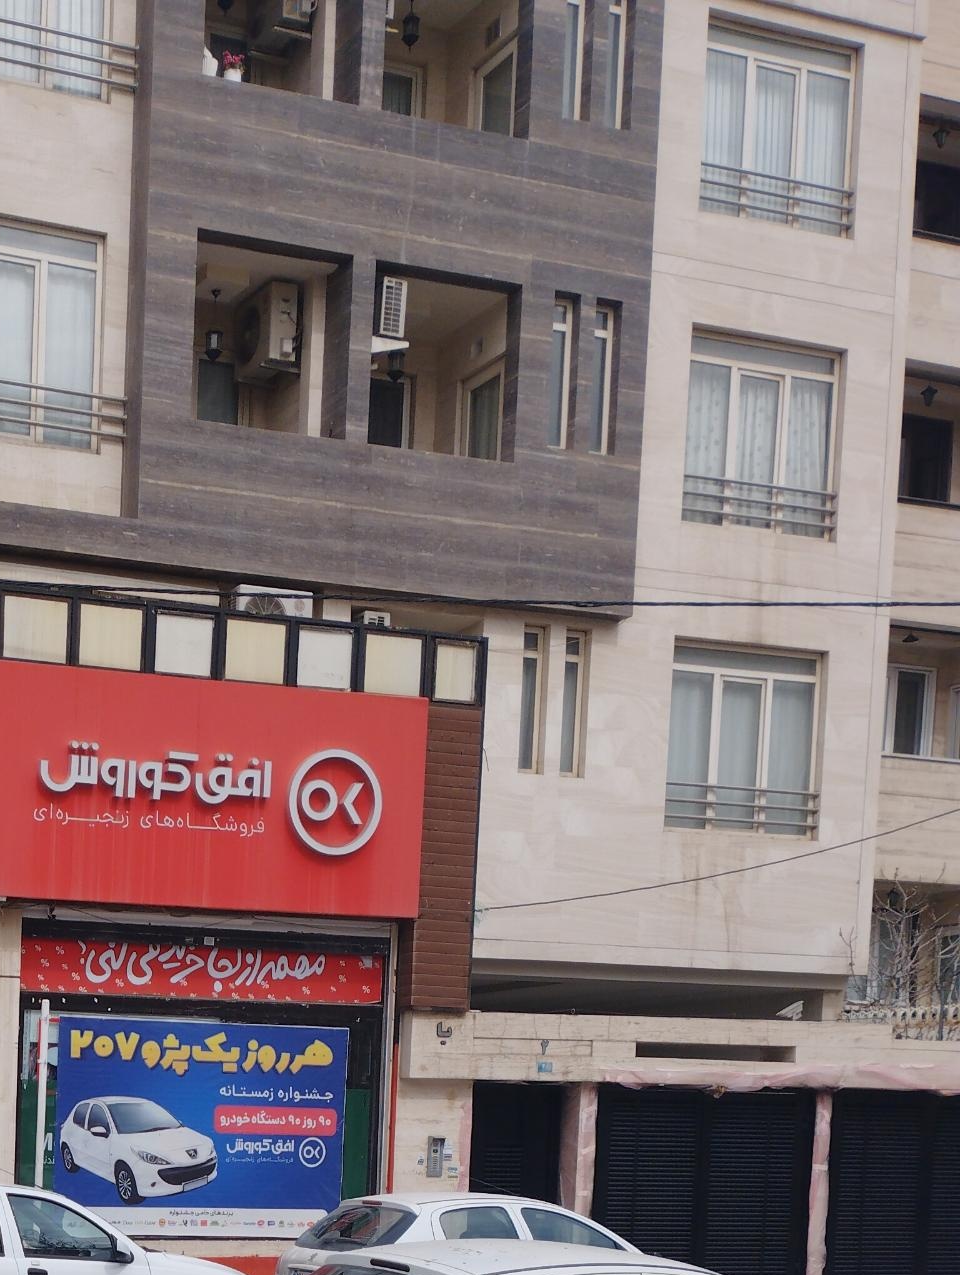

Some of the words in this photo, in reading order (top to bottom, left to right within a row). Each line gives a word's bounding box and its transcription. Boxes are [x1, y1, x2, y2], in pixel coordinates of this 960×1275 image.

[40, 740, 199, 801] کوروش
[195, 752, 273, 805] افق
[70, 1029, 140, 1061] ۲۰۷
[191, 1031, 241, 1073] یک
[140, 1033, 191, 1076] پژو
[242, 1039, 291, 1075] روز
[289, 1039, 334, 1075] هر
[219, 1083, 274, 1102] زمستانه
[278, 1085, 334, 1103] جشنواره
[219, 1112, 251, 1127] خودرو
[251, 1110, 287, 1126] دستگاه
[287, 1114, 301, 1126] ۹۰
[302, 1114, 317, 1129] روز
[318, 1115, 332, 1127] ۹۰
[226, 1138, 273, 1155] کوروش
[271, 1138, 296, 1155] افق
